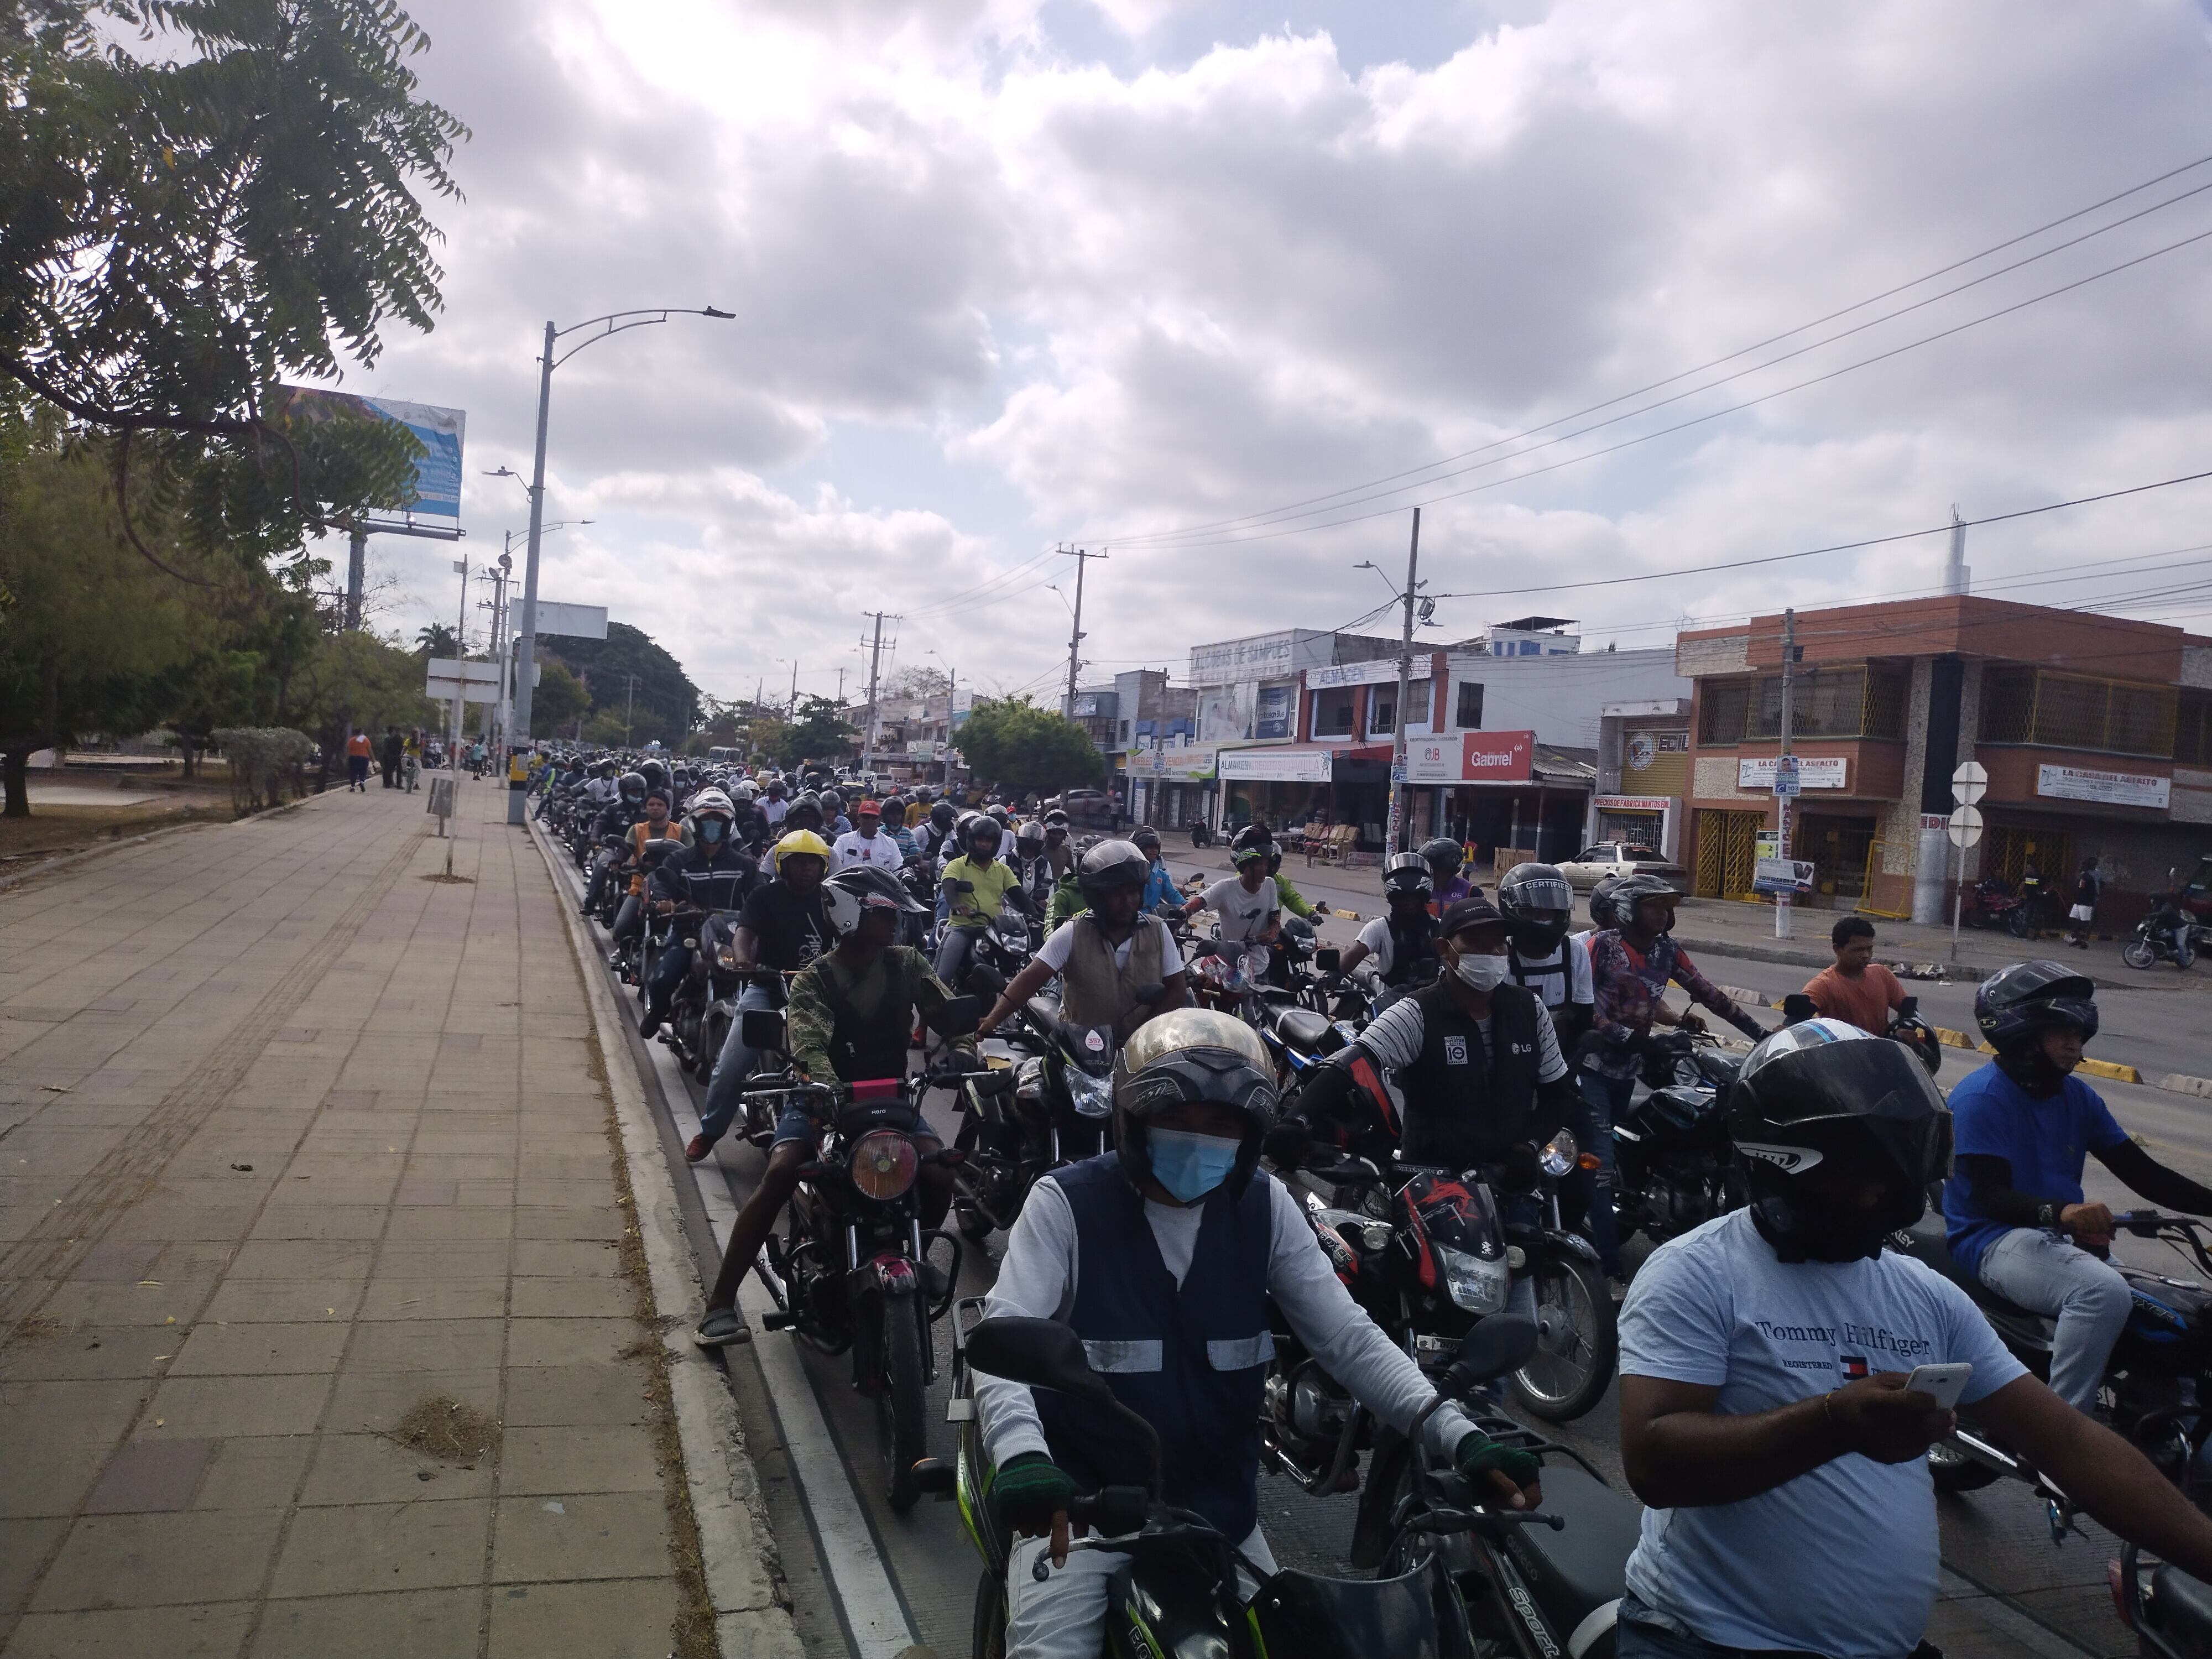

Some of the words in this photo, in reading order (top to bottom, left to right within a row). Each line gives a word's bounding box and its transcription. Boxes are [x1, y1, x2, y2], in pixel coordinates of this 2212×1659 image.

[1235, 645, 1246, 665] DE
[1220, 760, 1249, 770] ALMACEN
[1472, 750, 1512, 766] Gabriel
[2076, 770, 2100, 779] CASA
[2120, 775, 2157, 786] ASFALTO
[1595, 799, 1613, 807] PRECIOS
[1526, 881, 1569, 891] CERTIFIED
[1521, 1044, 1532, 1053] LG
[1318, 1230, 1354, 1265] BOXER
[2131, 1295, 2177, 1323] OXER
[1755, 1321, 1837, 1347] Tommy
[1844, 1322, 1931, 1357] Hilfiger
[1782, 1359, 1833, 1370] REGISTERED
[1128, 1625, 1155, 1659] BO
